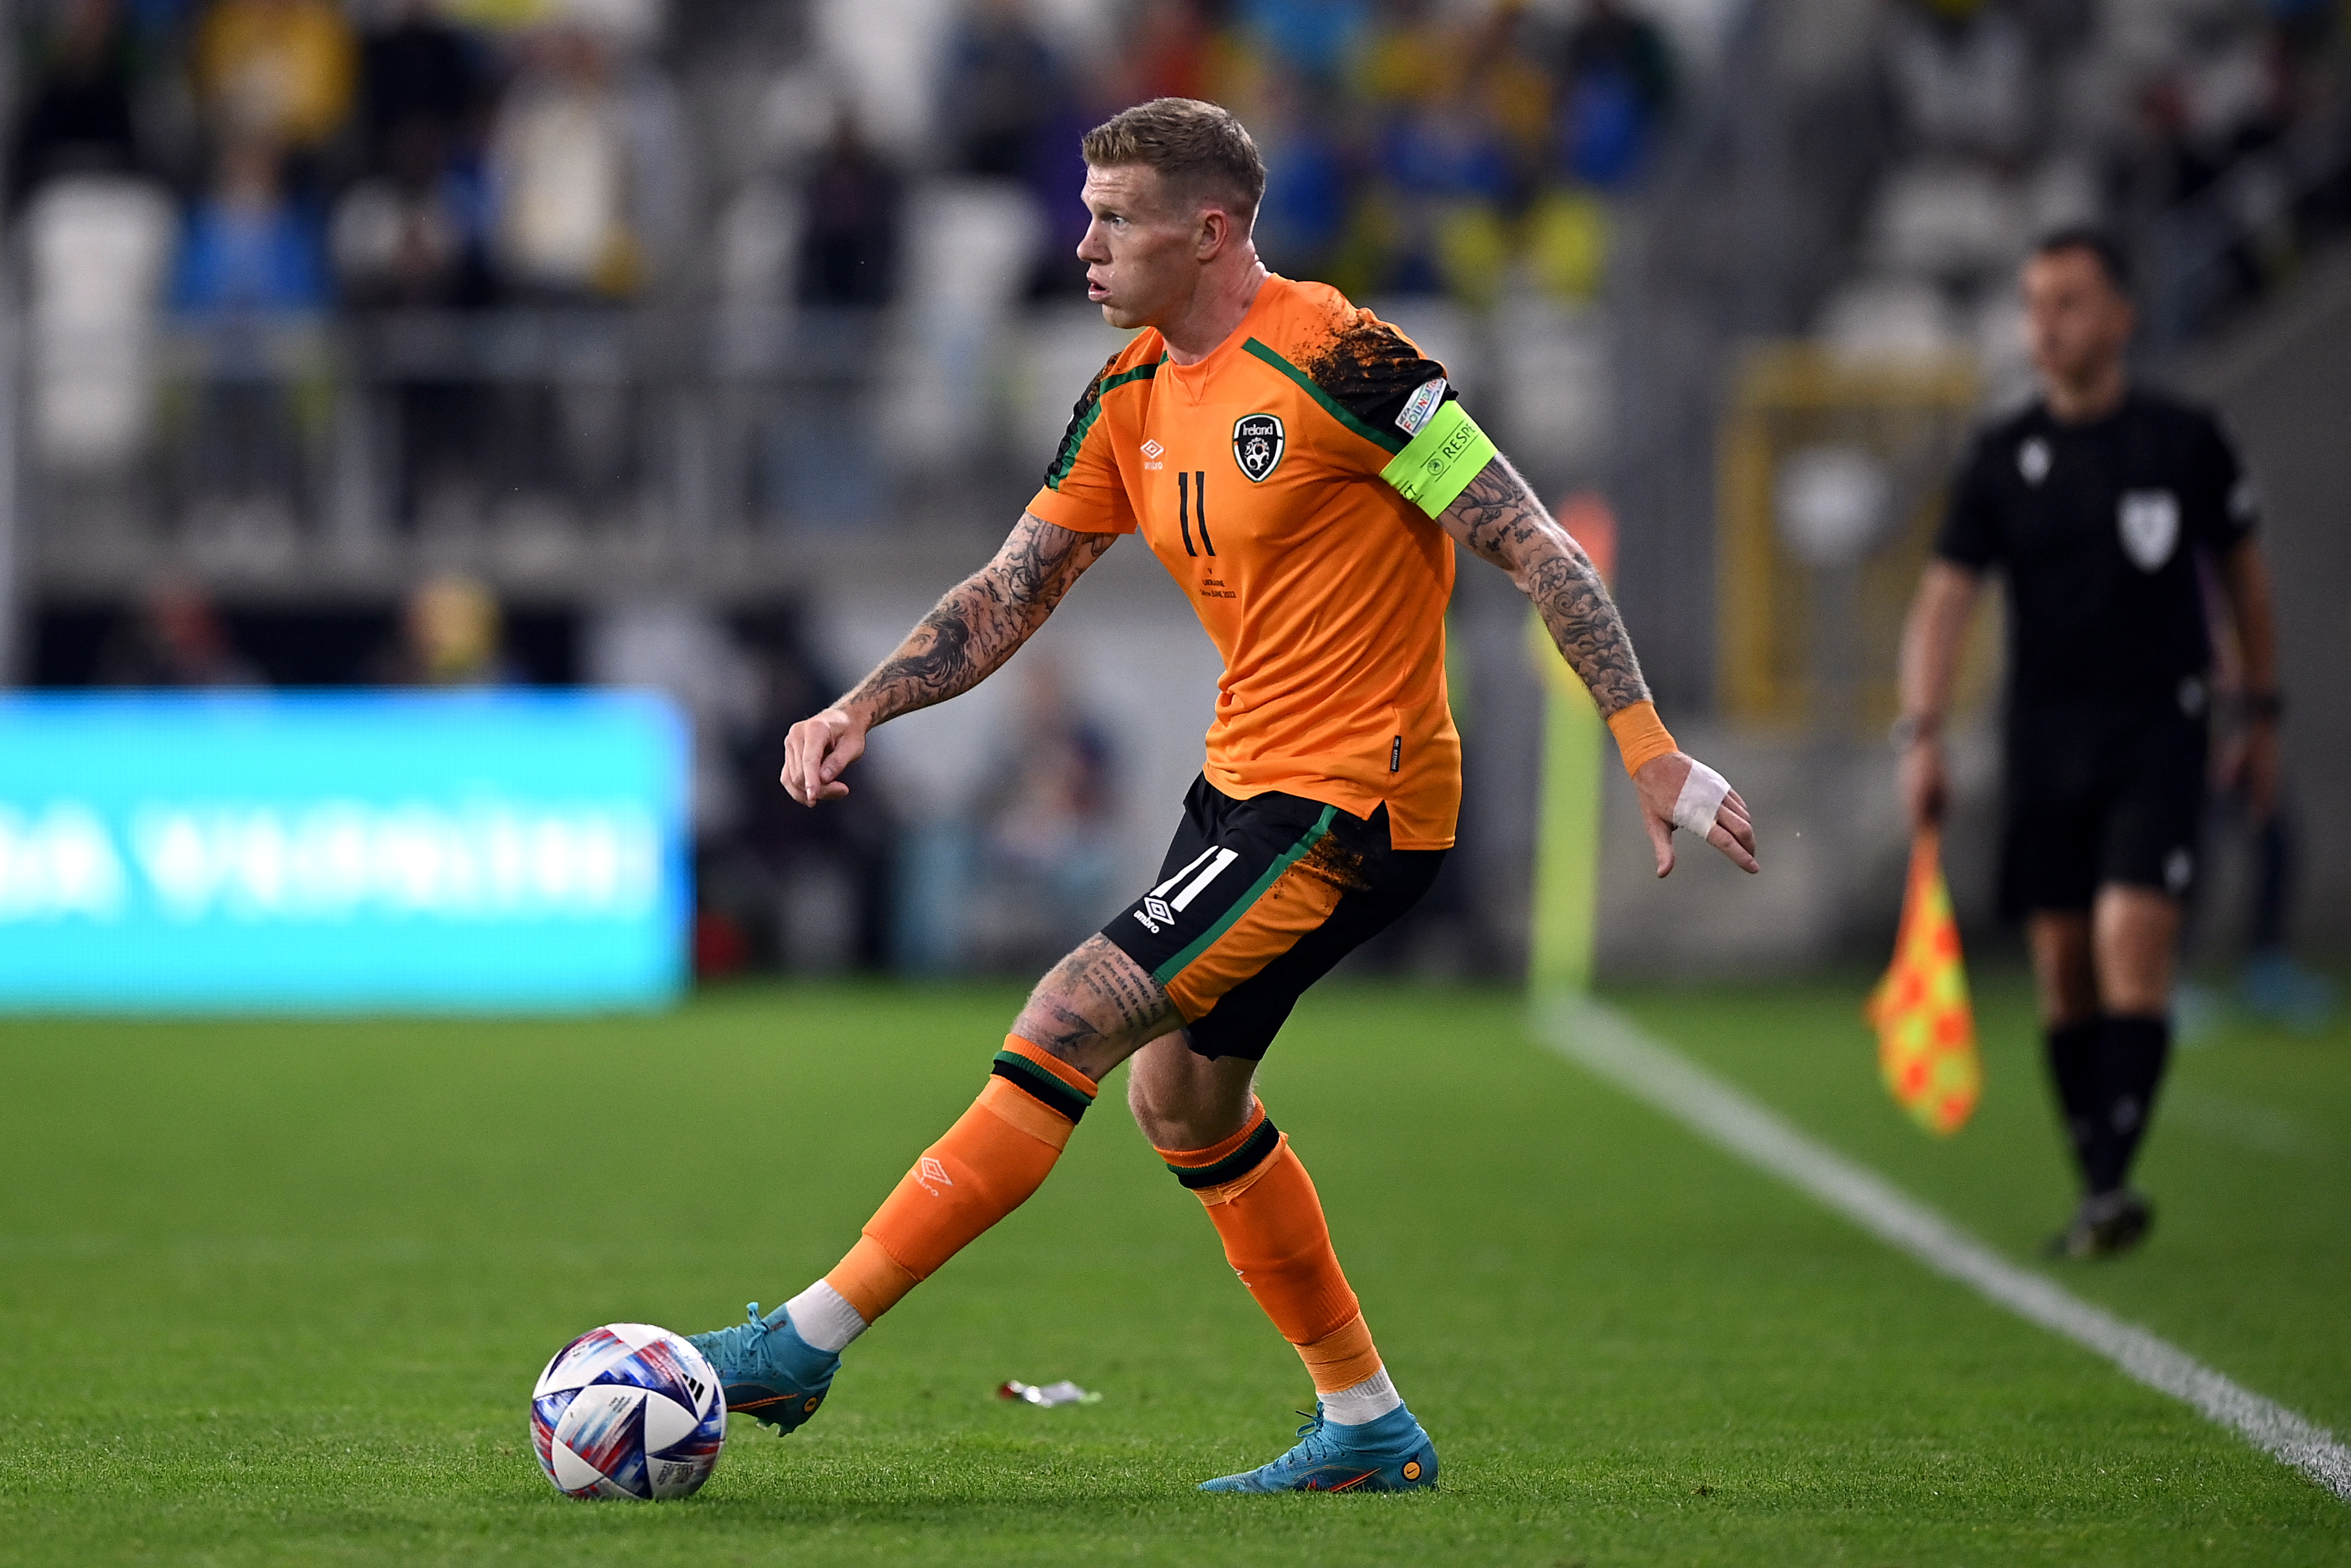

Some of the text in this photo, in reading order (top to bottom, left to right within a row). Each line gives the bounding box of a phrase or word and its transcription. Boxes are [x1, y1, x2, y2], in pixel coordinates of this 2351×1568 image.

[1242, 423, 1273, 436] Ireland
[1178, 471, 1216, 557] 11
[1201, 579, 1225, 587] UKRAINE
[1149, 845, 1239, 913] 11
[1133, 909, 1160, 934] umbro
